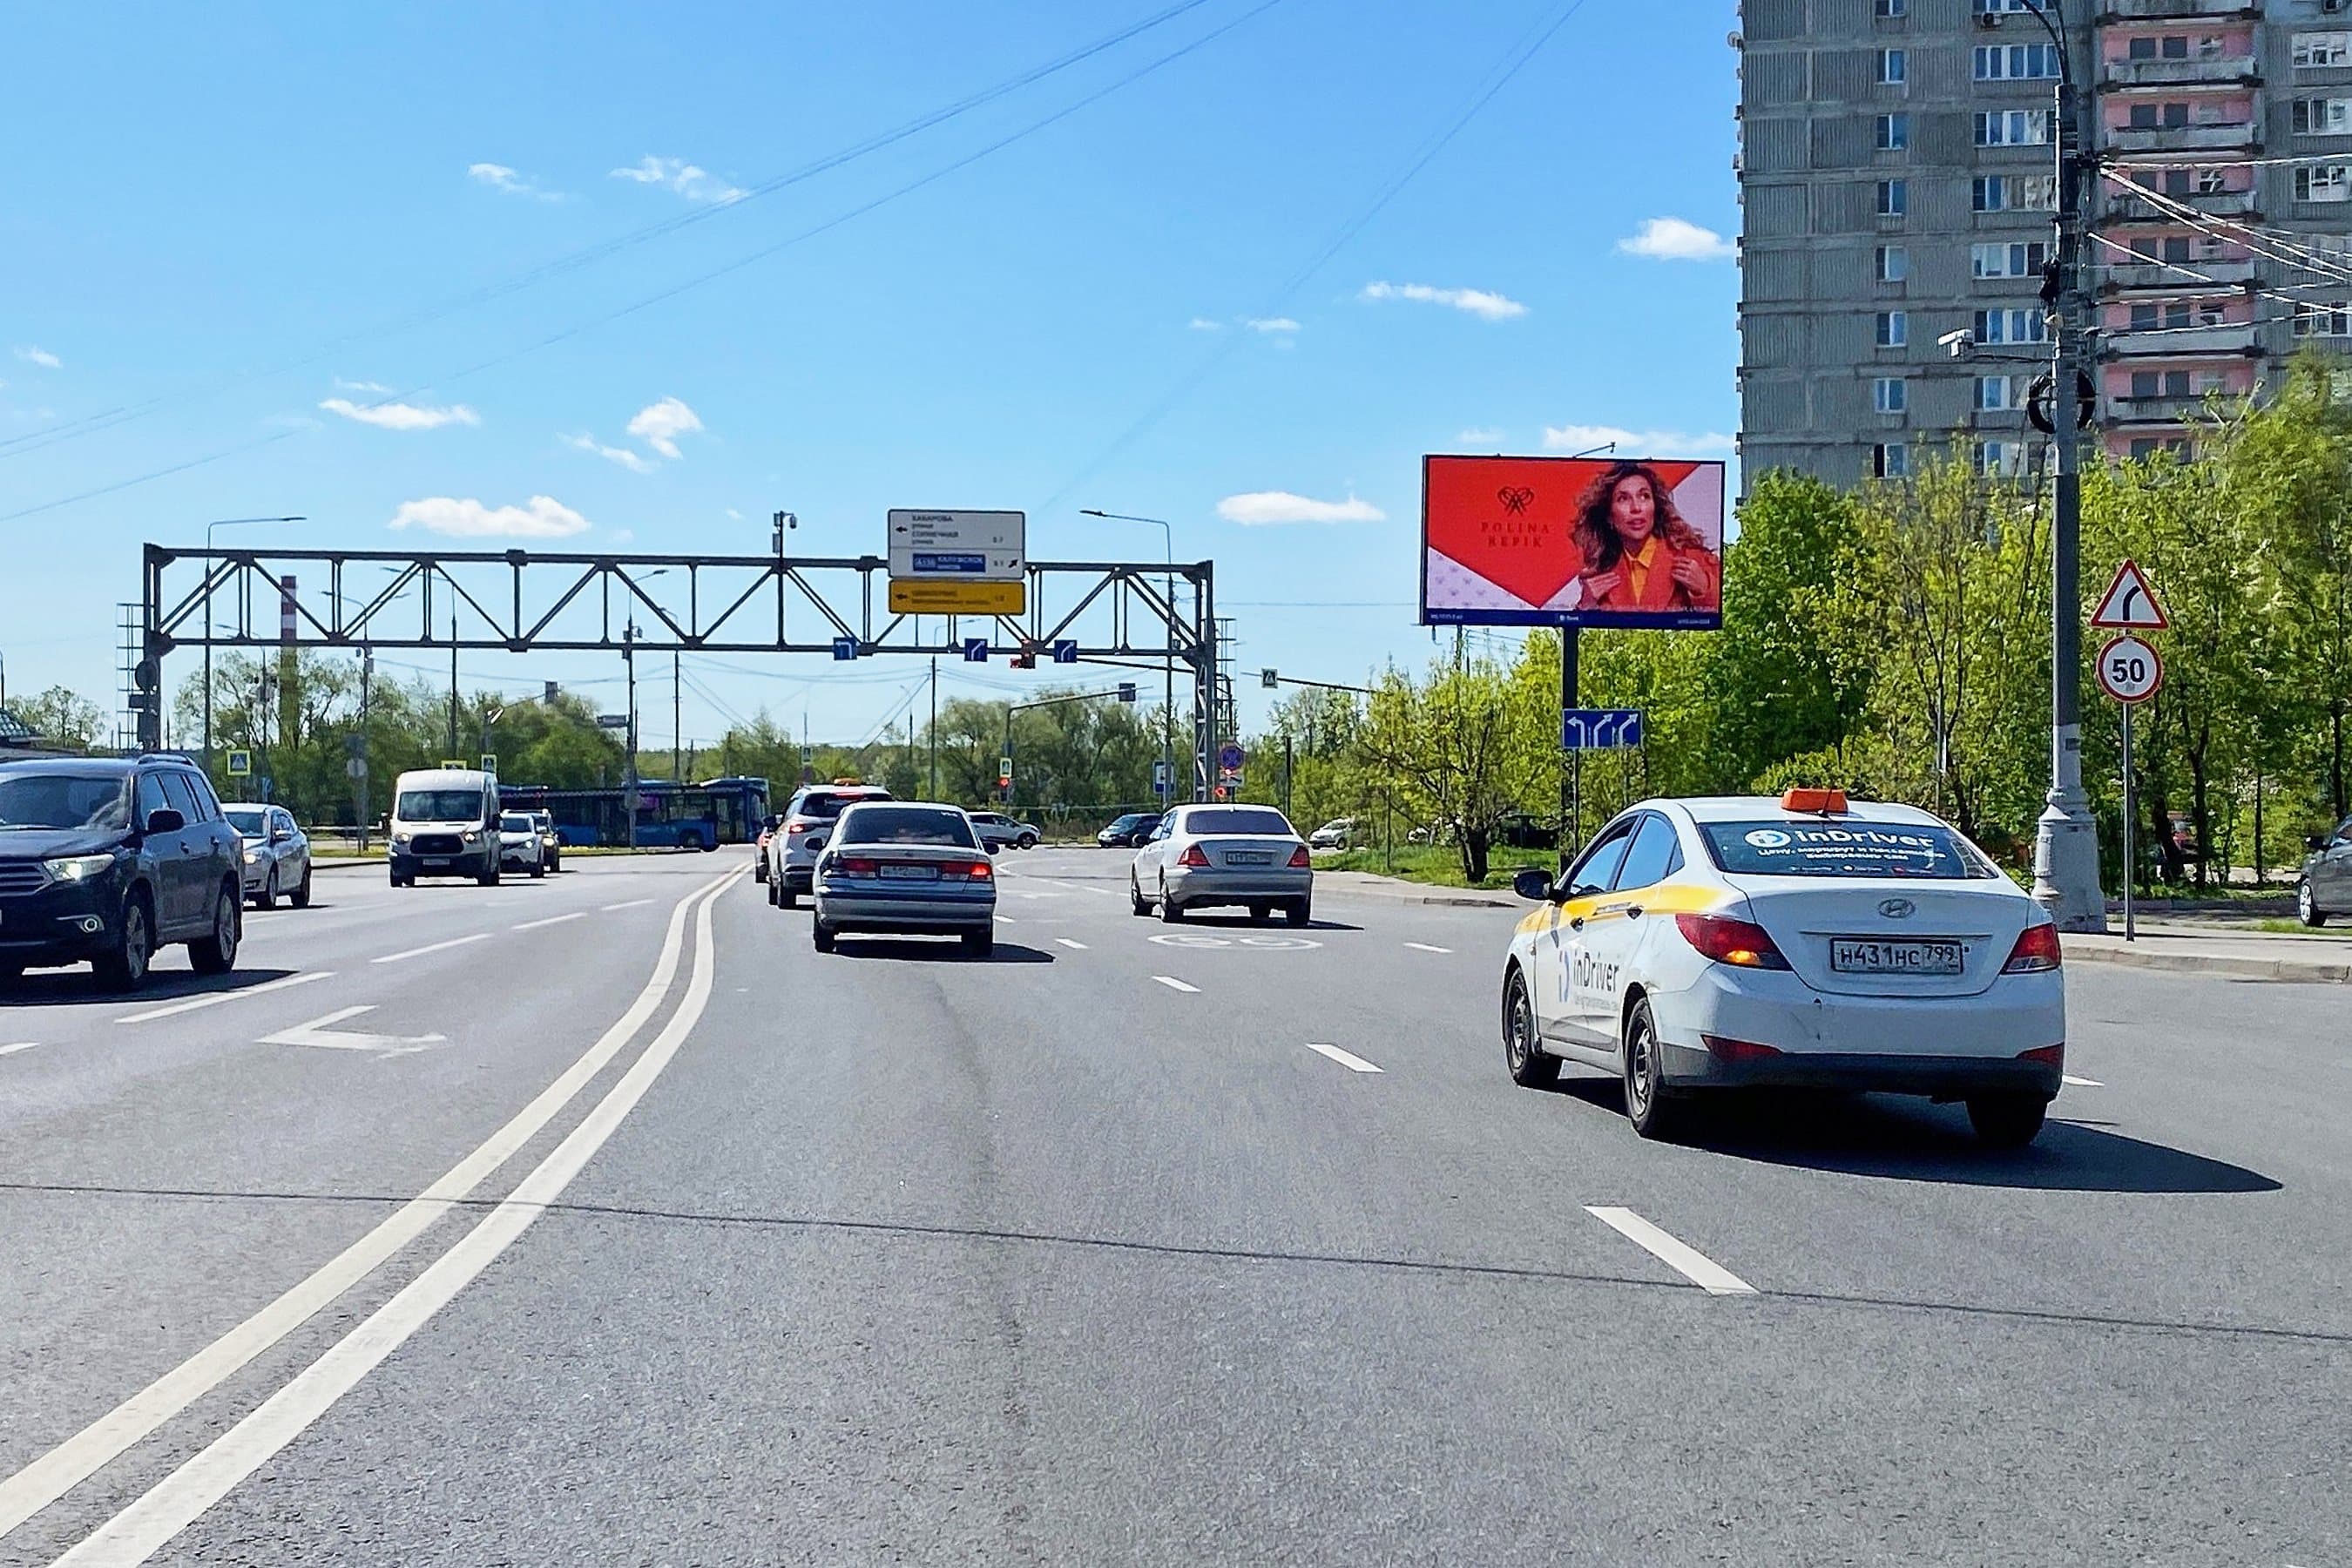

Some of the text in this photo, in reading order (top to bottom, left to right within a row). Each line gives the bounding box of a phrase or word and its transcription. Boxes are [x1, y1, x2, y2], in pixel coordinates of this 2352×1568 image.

[1481, 522, 1549, 534] POLINA
[2112, 658, 2145, 683] 50
[1794, 830, 1934, 848] inDriver
[1573, 950, 1619, 993] inDriver
